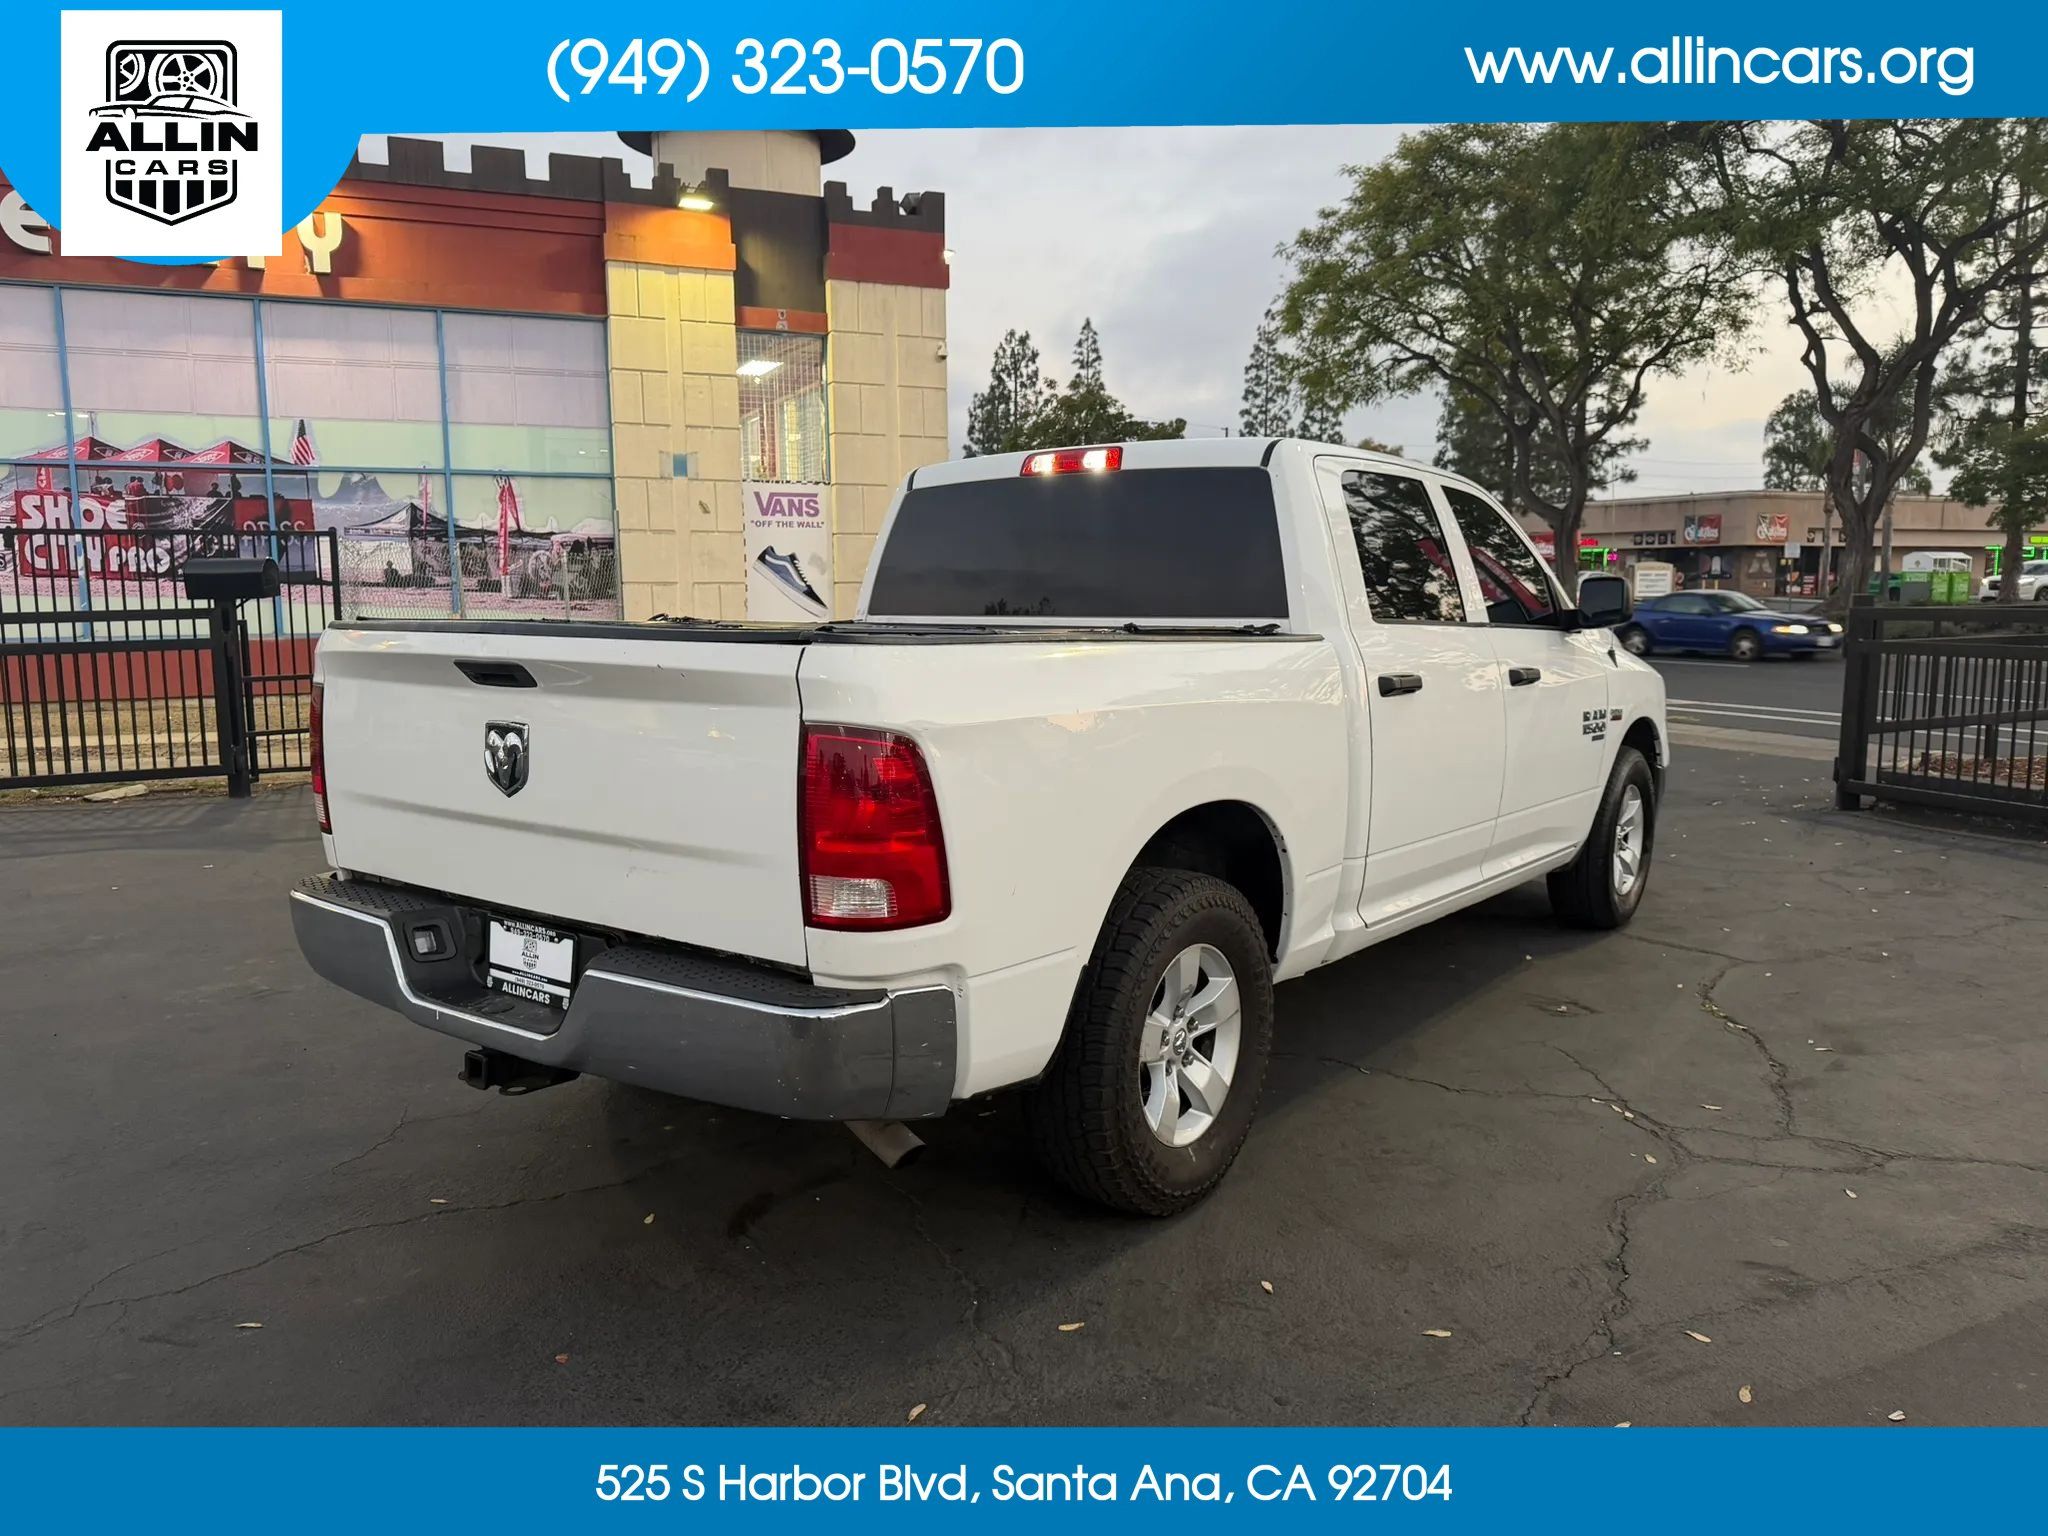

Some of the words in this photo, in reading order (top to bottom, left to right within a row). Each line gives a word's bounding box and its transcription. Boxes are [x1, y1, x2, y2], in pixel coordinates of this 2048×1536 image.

[20, 494, 128, 532] SHOE
[753, 491, 820, 518] VANS
[775, 520, 794, 529] THE
[521, 950, 540, 961] ALLIN
[502, 981, 551, 1004] ALLINCARS
